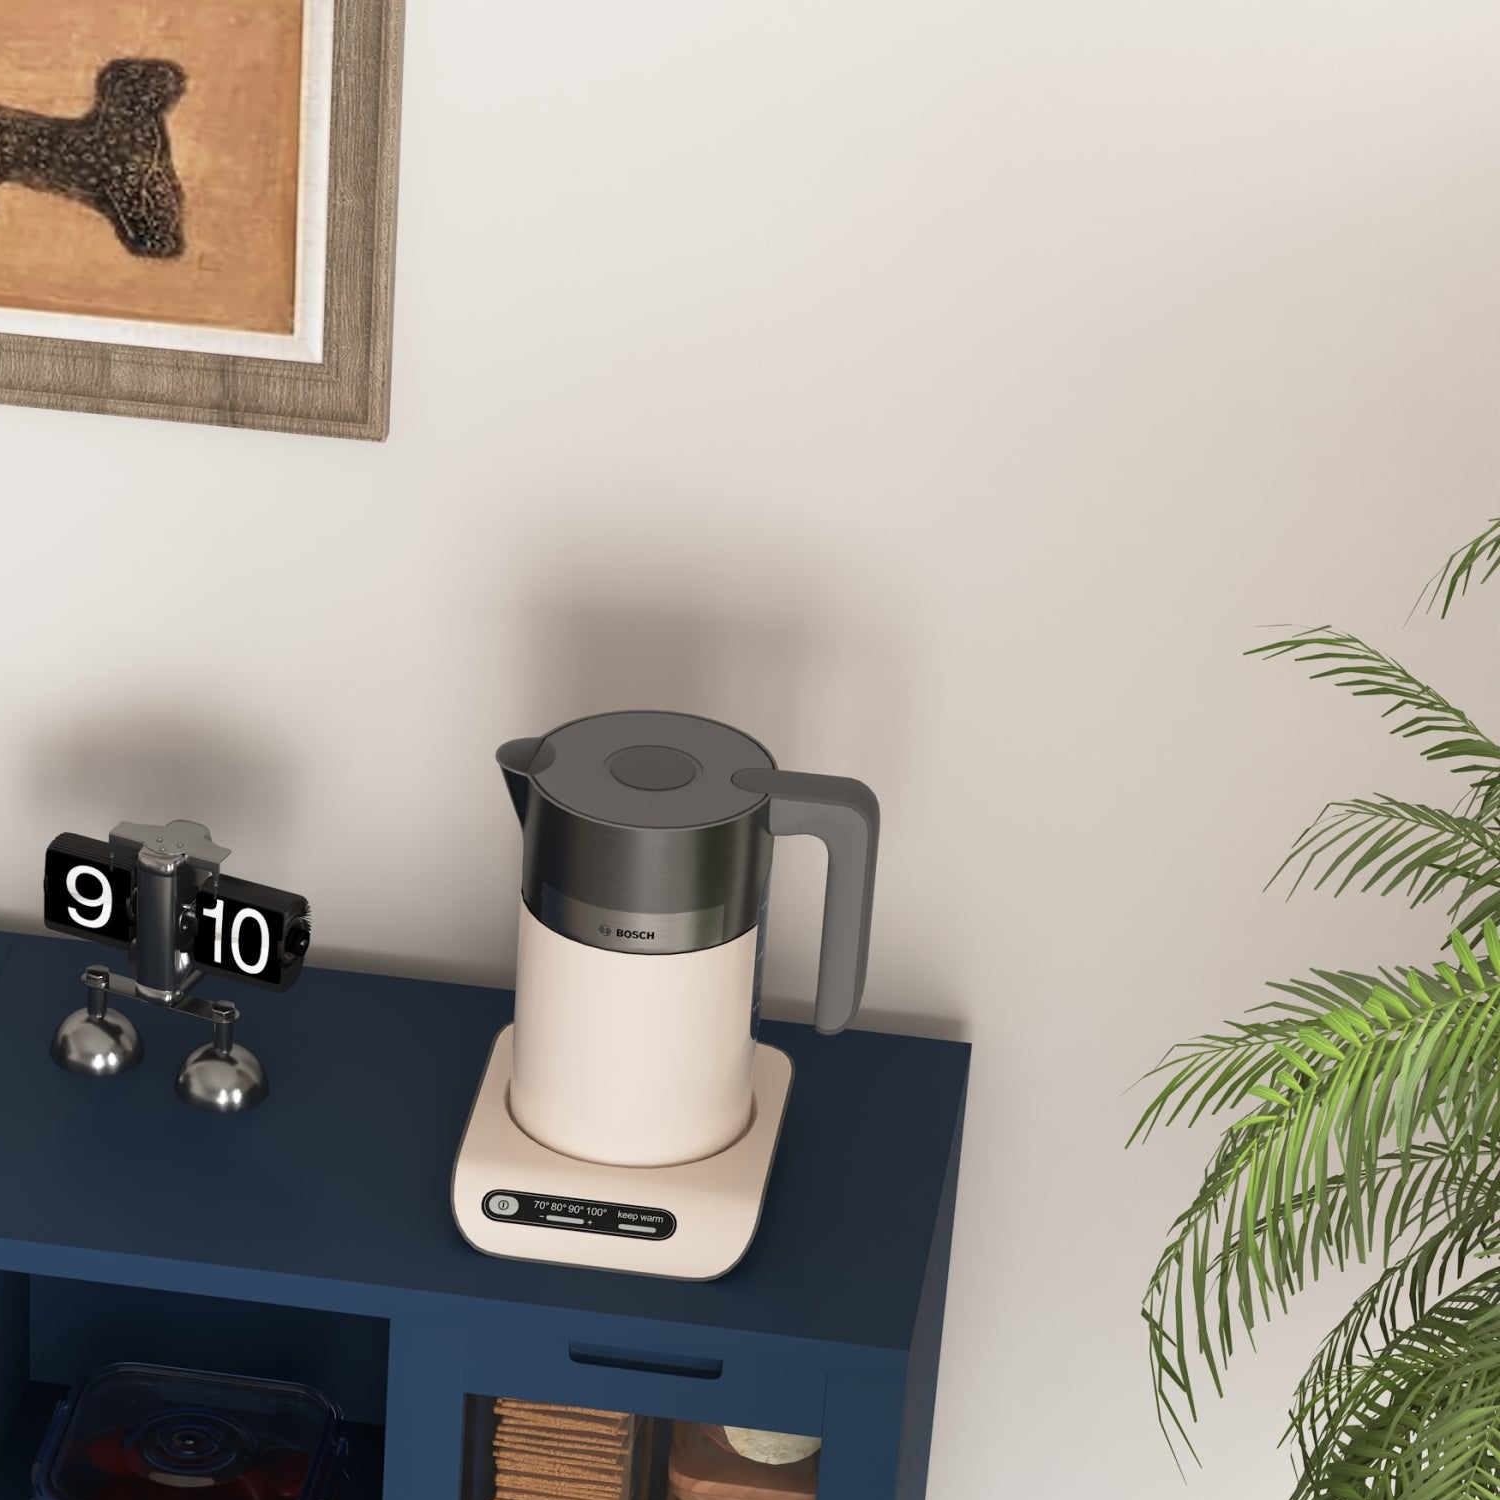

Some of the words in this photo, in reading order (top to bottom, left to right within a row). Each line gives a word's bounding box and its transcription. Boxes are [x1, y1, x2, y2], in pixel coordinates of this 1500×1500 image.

[66, 864, 113, 929] 9
[202, 899, 270, 975] 10
[616, 928, 655, 941] BOSCH
[617, 1210, 639, 1222] keep
[640, 1214, 664, 1224] warm
